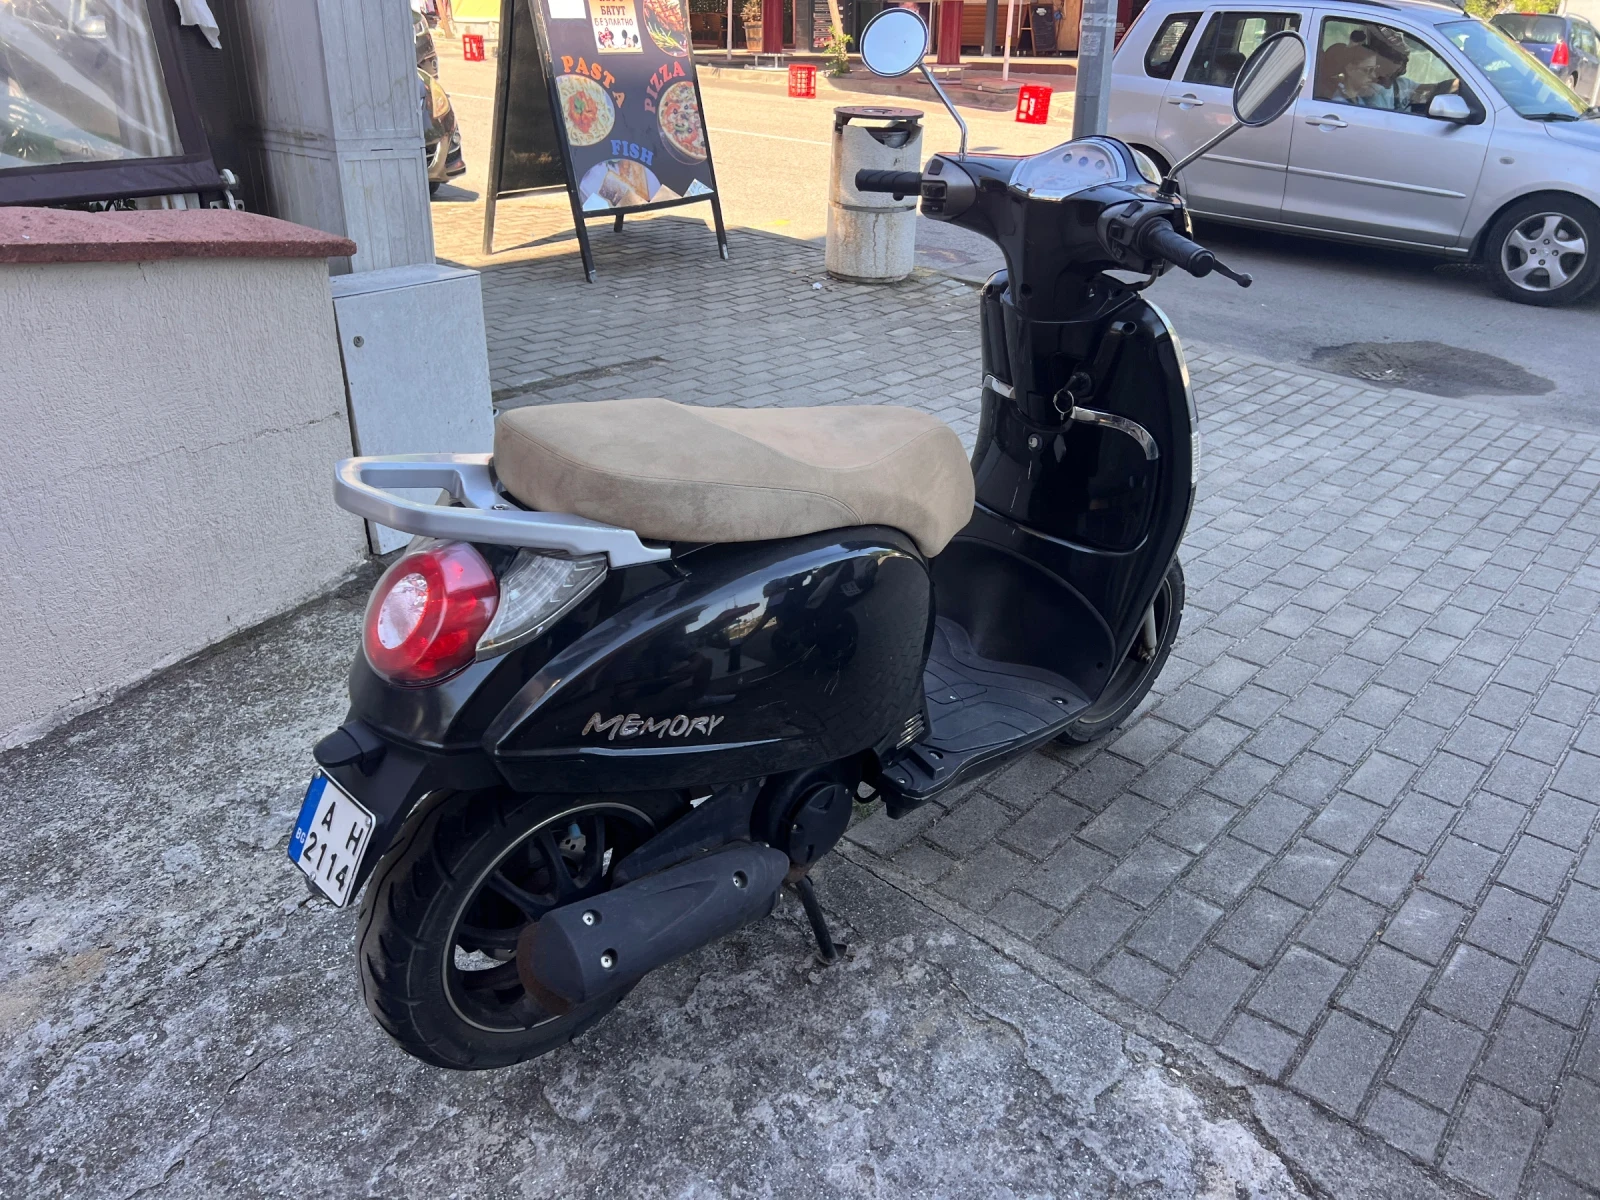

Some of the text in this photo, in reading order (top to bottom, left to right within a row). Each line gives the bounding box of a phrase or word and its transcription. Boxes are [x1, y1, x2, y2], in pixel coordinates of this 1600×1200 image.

[594, 17, 634, 27] БЕЗПЛАТНО
[600, 5, 626, 16] БАТУТ
[644, 61, 685, 114] PIZZA
[610, 139, 654, 165] FISH
[581, 712, 725, 741] MEMORY
[295, 827, 307, 844] BG
[321, 801, 364, 856] A H
[302, 831, 349, 892] 2114
